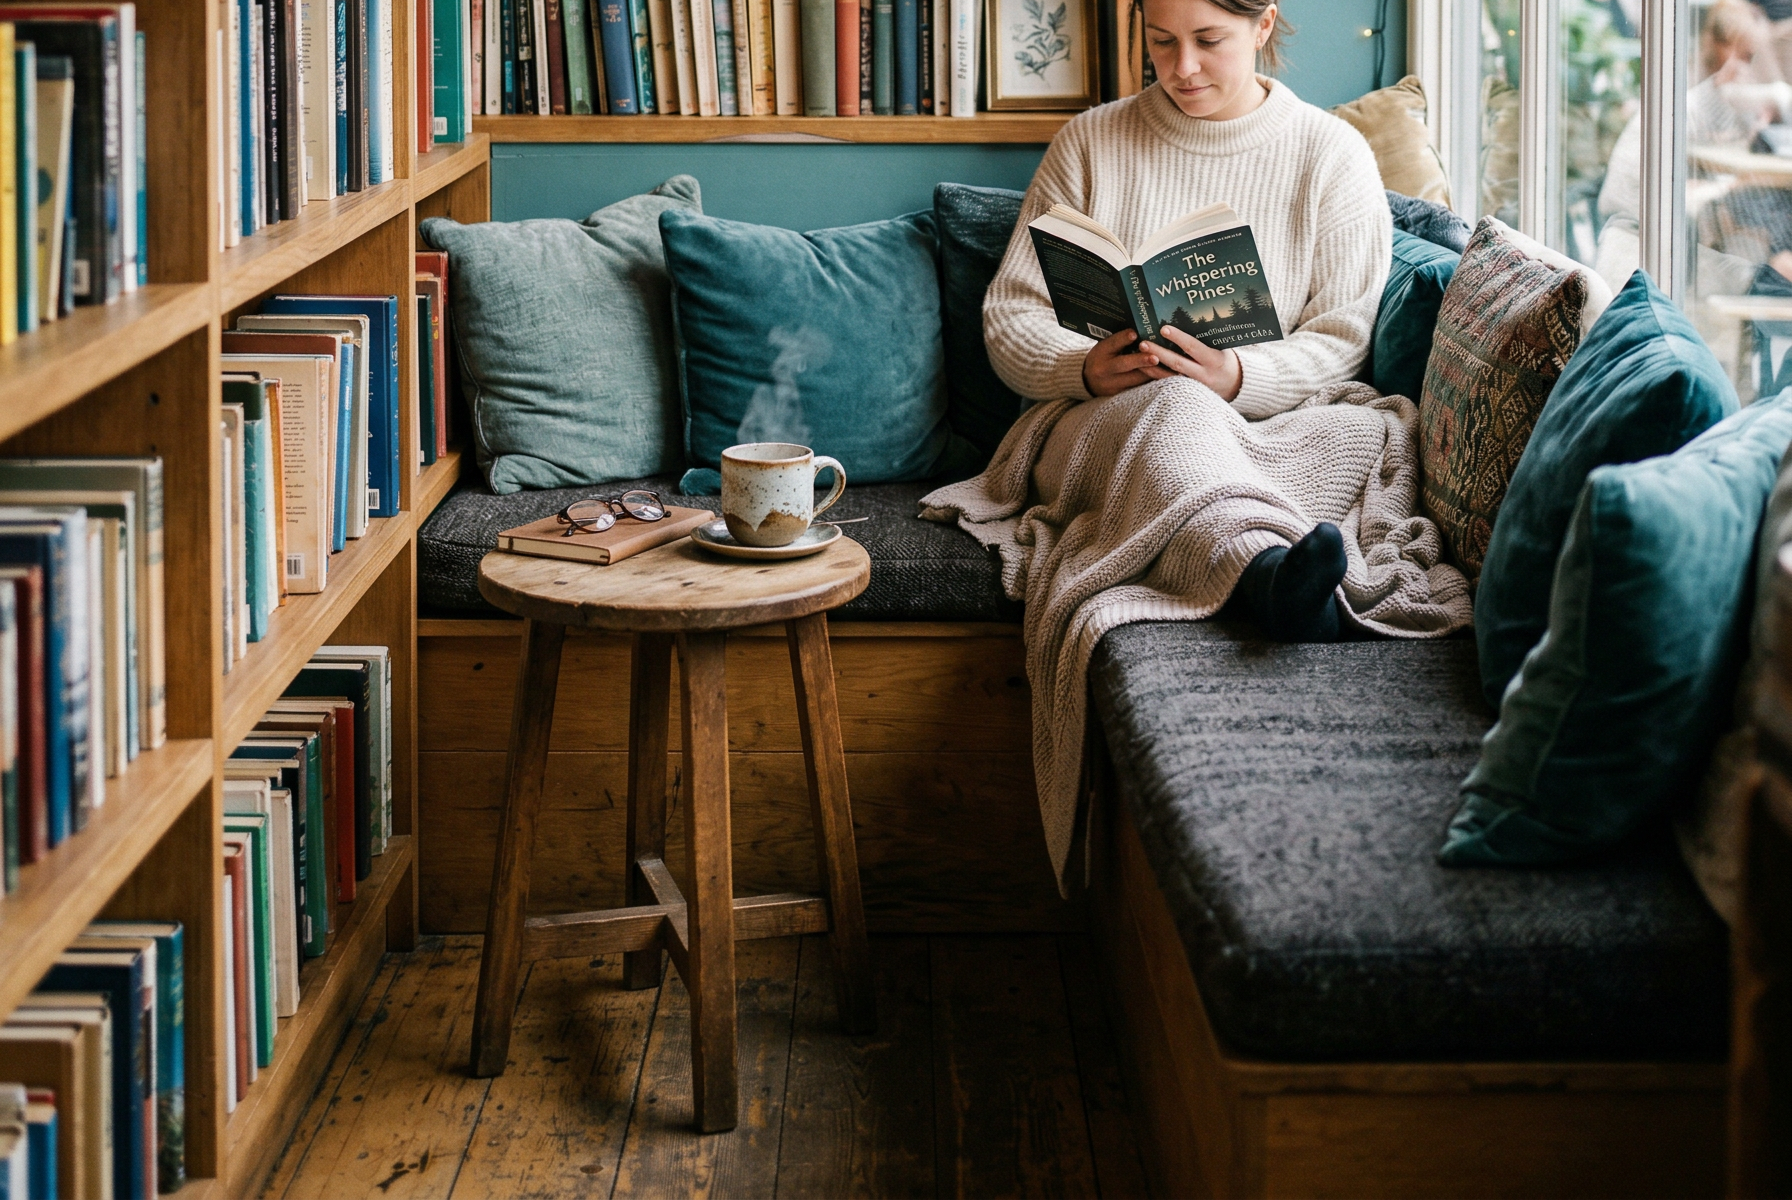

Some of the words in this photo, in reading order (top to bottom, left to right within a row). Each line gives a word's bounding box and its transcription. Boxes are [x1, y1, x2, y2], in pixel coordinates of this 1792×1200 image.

[1182, 252, 1216, 270] The
[1155, 261, 1258, 298] Whispering
[1186, 283, 1235, 305] Pines
